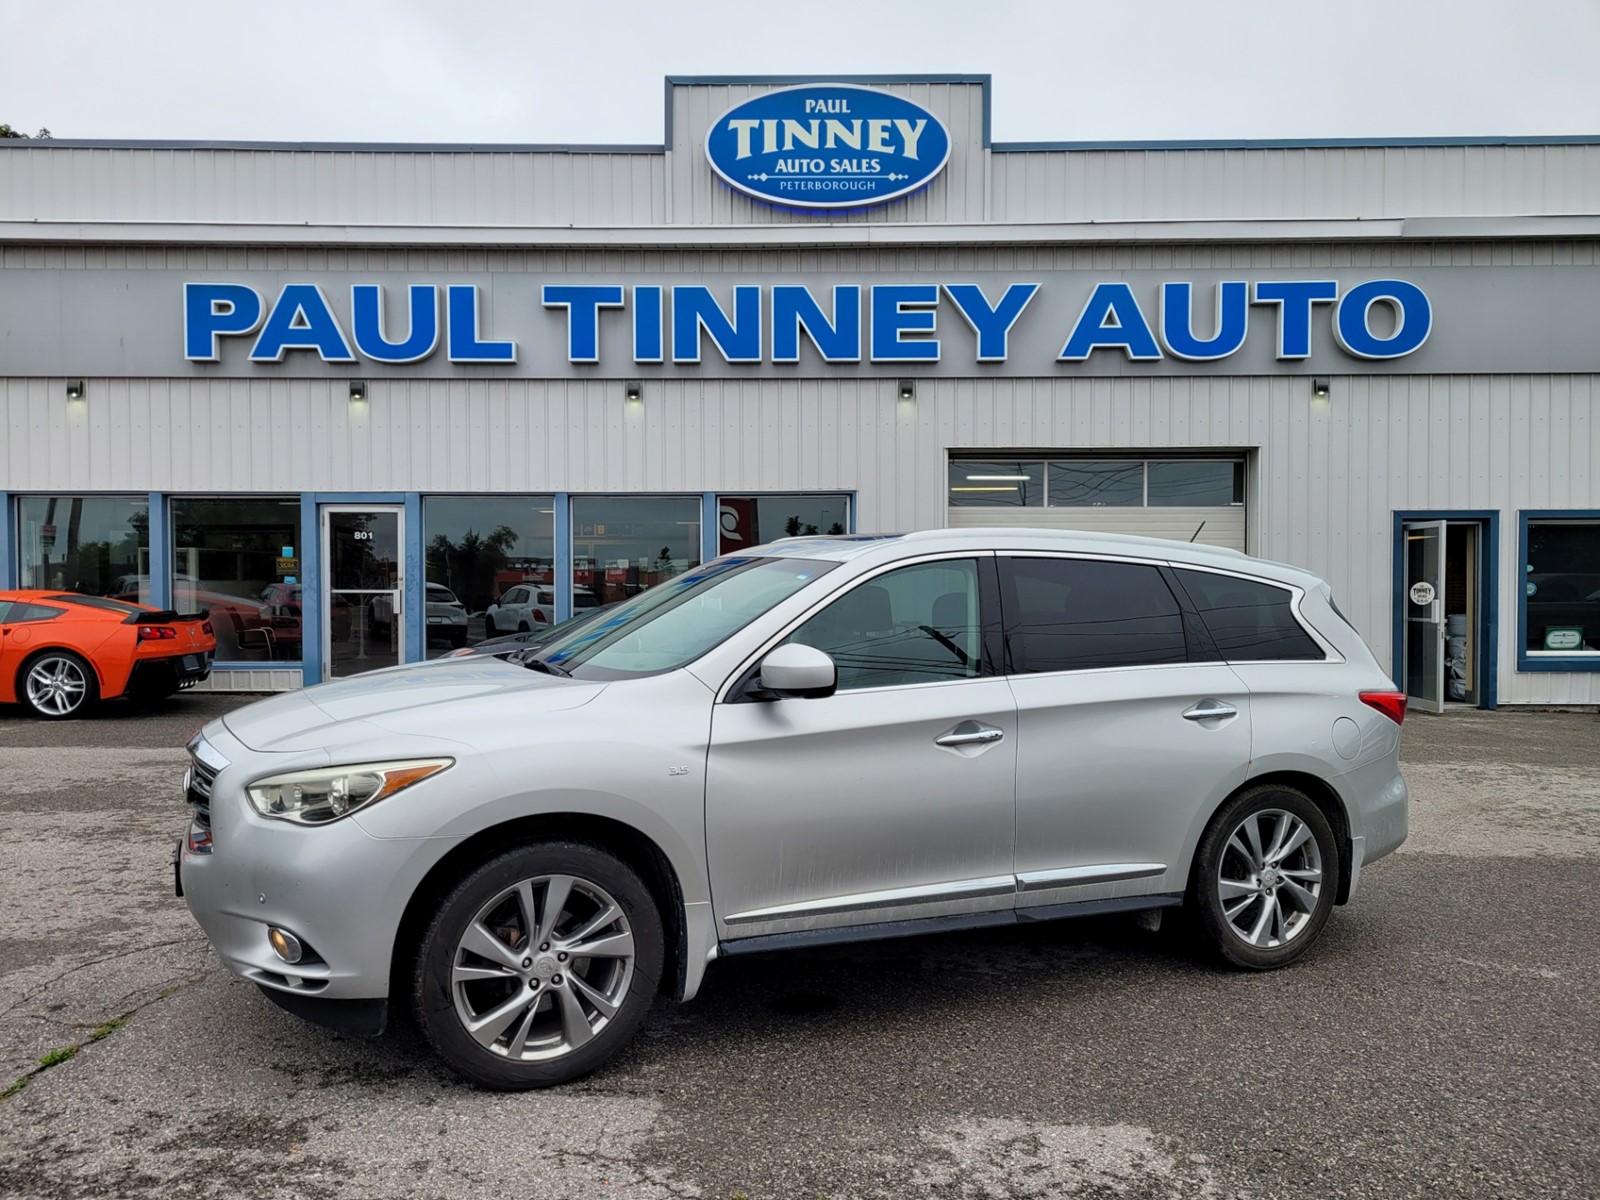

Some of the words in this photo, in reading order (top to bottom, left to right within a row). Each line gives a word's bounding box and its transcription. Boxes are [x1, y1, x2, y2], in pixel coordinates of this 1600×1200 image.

[805, 99, 851, 114] PAUL
[727, 119, 928, 161] TINNEY
[775, 158, 826, 173] AUTO
[830, 158, 881, 173] SALES
[780, 180, 876, 191] PETERBOROUGH
[183, 282, 517, 364] PAUL
[541, 281, 1043, 363] TINNEY
[1056, 278, 1433, 361] AUTO
[354, 531, 373, 540] 801
